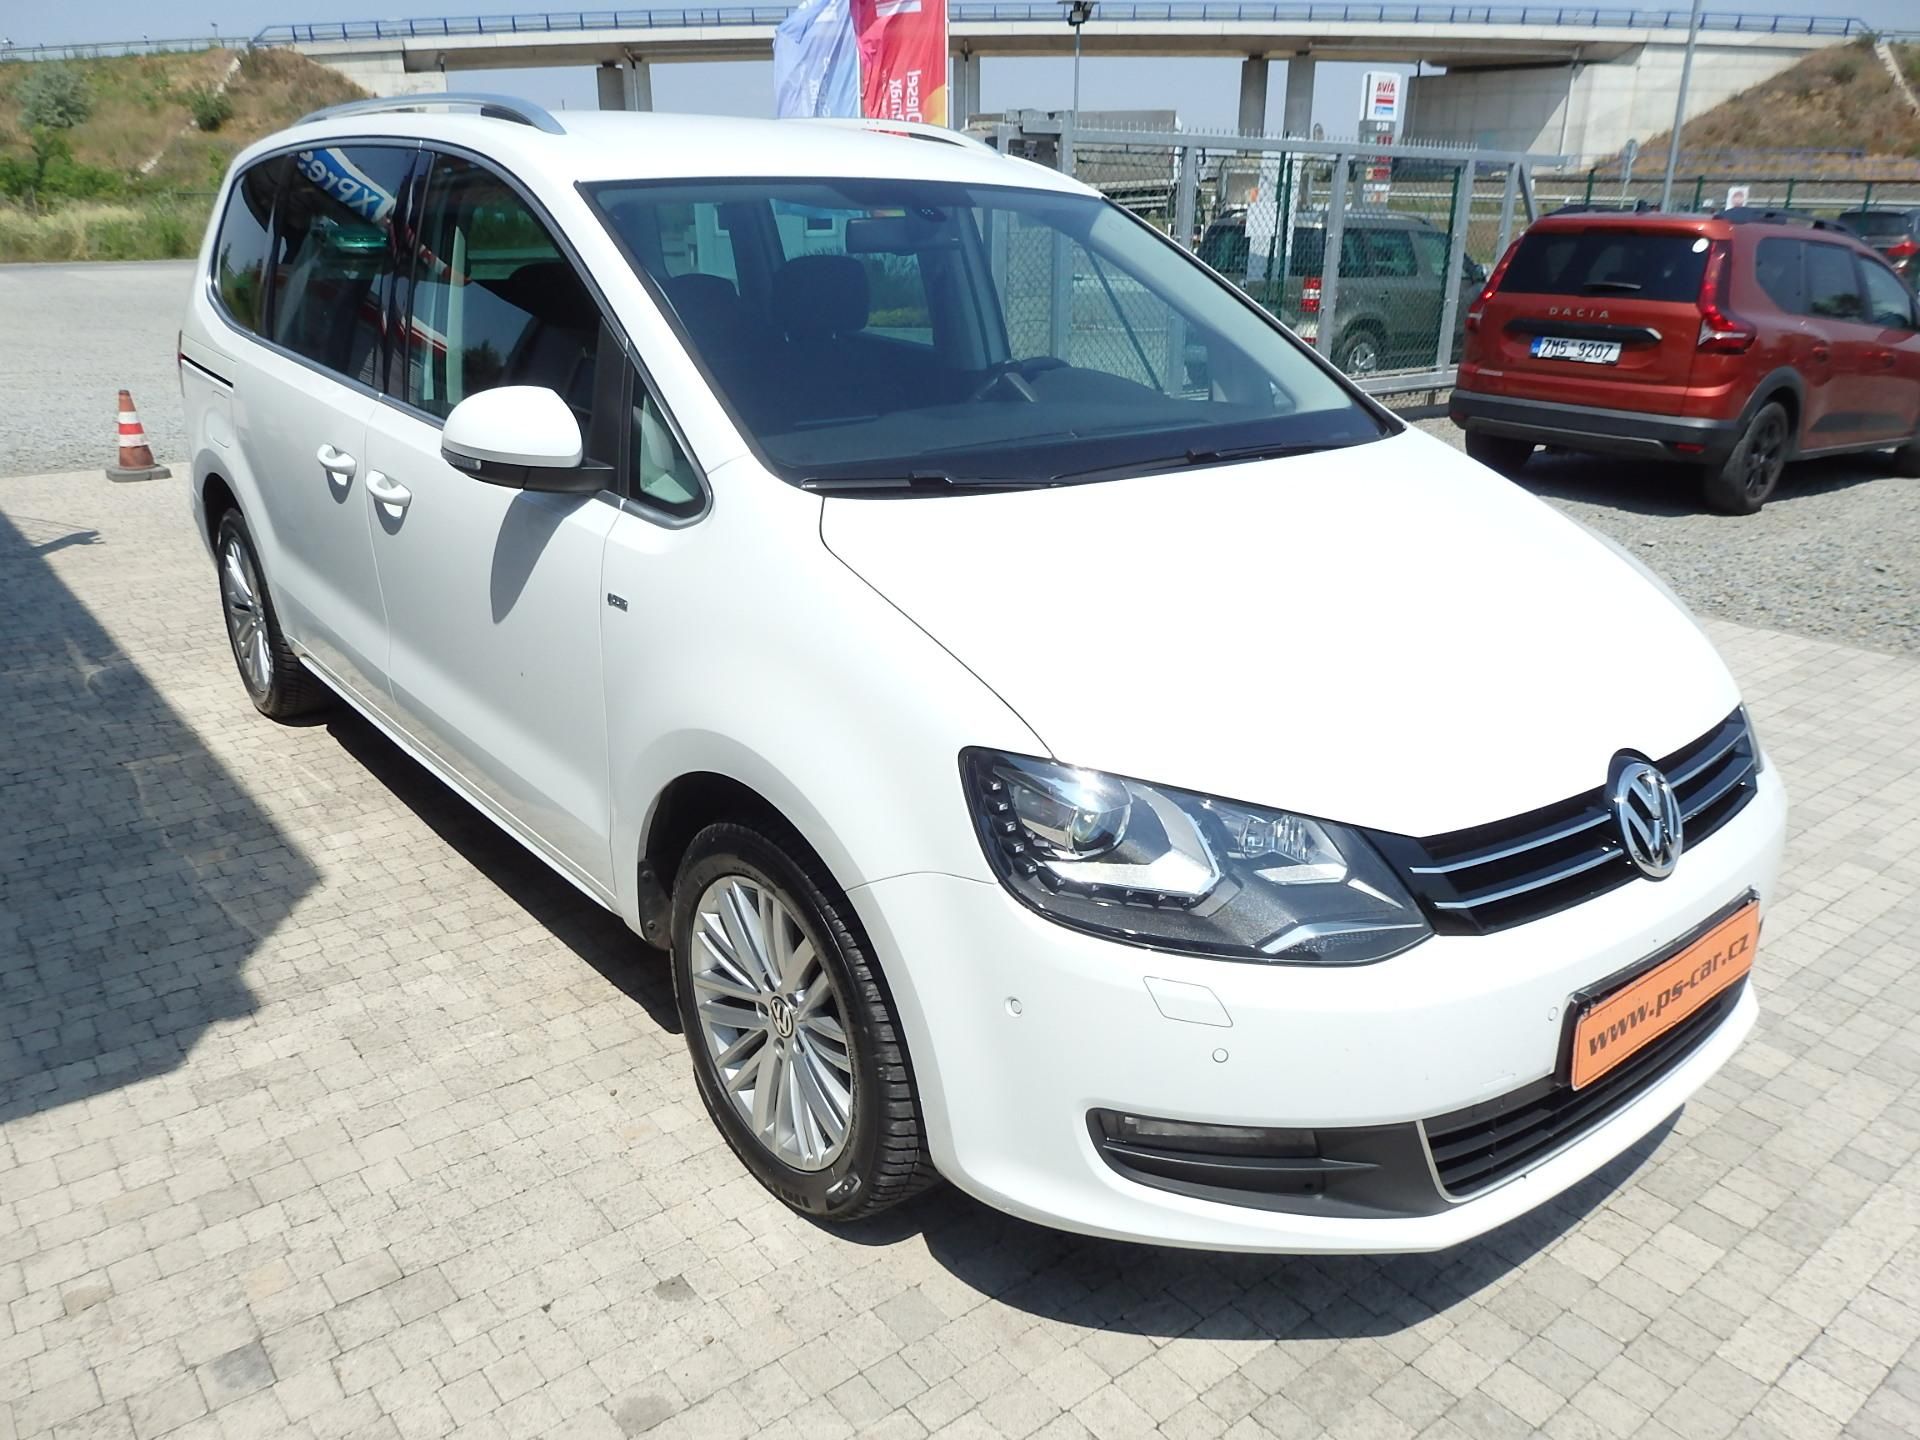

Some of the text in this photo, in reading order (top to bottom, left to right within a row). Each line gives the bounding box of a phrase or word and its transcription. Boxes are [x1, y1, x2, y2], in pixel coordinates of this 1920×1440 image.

[1376, 81, 1395, 93] AVIA
[1548, 306, 1610, 319] DACIA
[1577, 342, 1614, 359] 9207
[1588, 933, 1750, 1056] www.ps-car.cz
